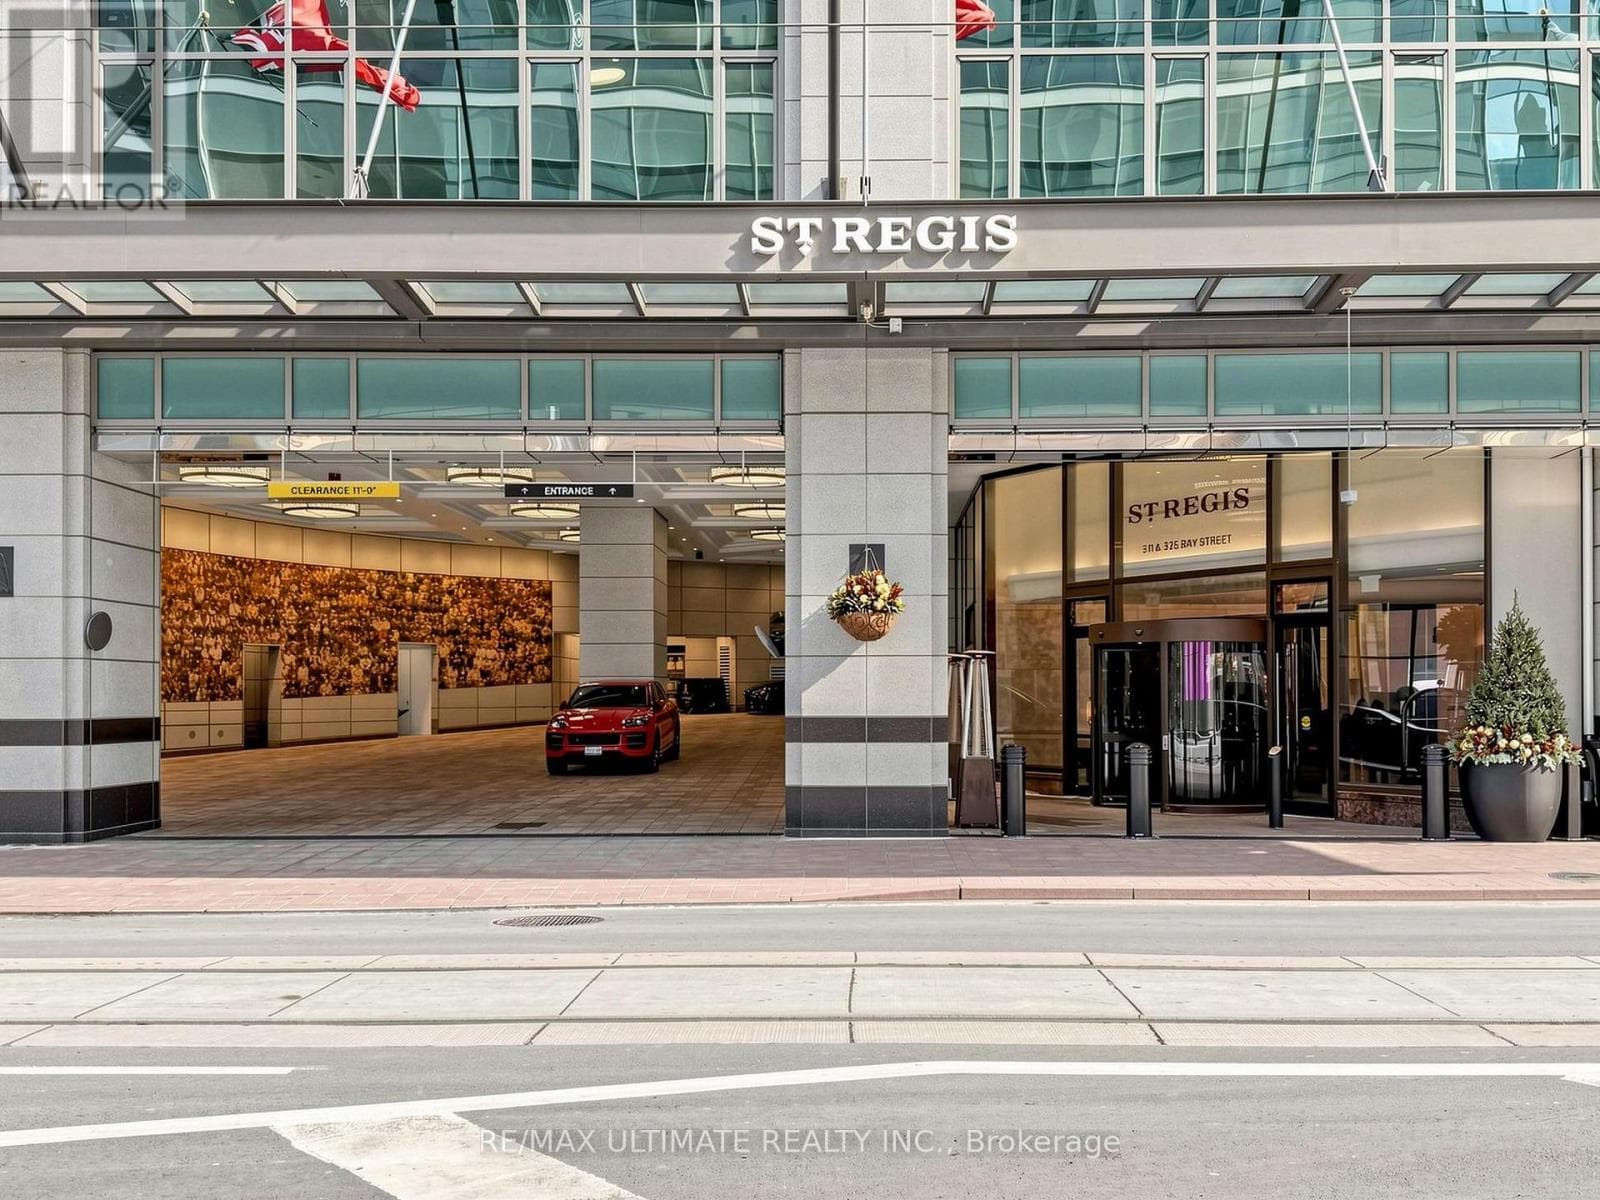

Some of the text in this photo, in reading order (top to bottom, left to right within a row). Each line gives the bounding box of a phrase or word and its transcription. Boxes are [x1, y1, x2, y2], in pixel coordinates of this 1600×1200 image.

[831, 214, 1018, 253] REGIS
[291, 486, 351, 495] CLEARANCE
[544, 486, 594, 495] ENTRANCE
[1164, 487, 1249, 519] REGIS
[1180, 538, 1198, 549] BAY
[1199, 534, 1232, 547] STREET
